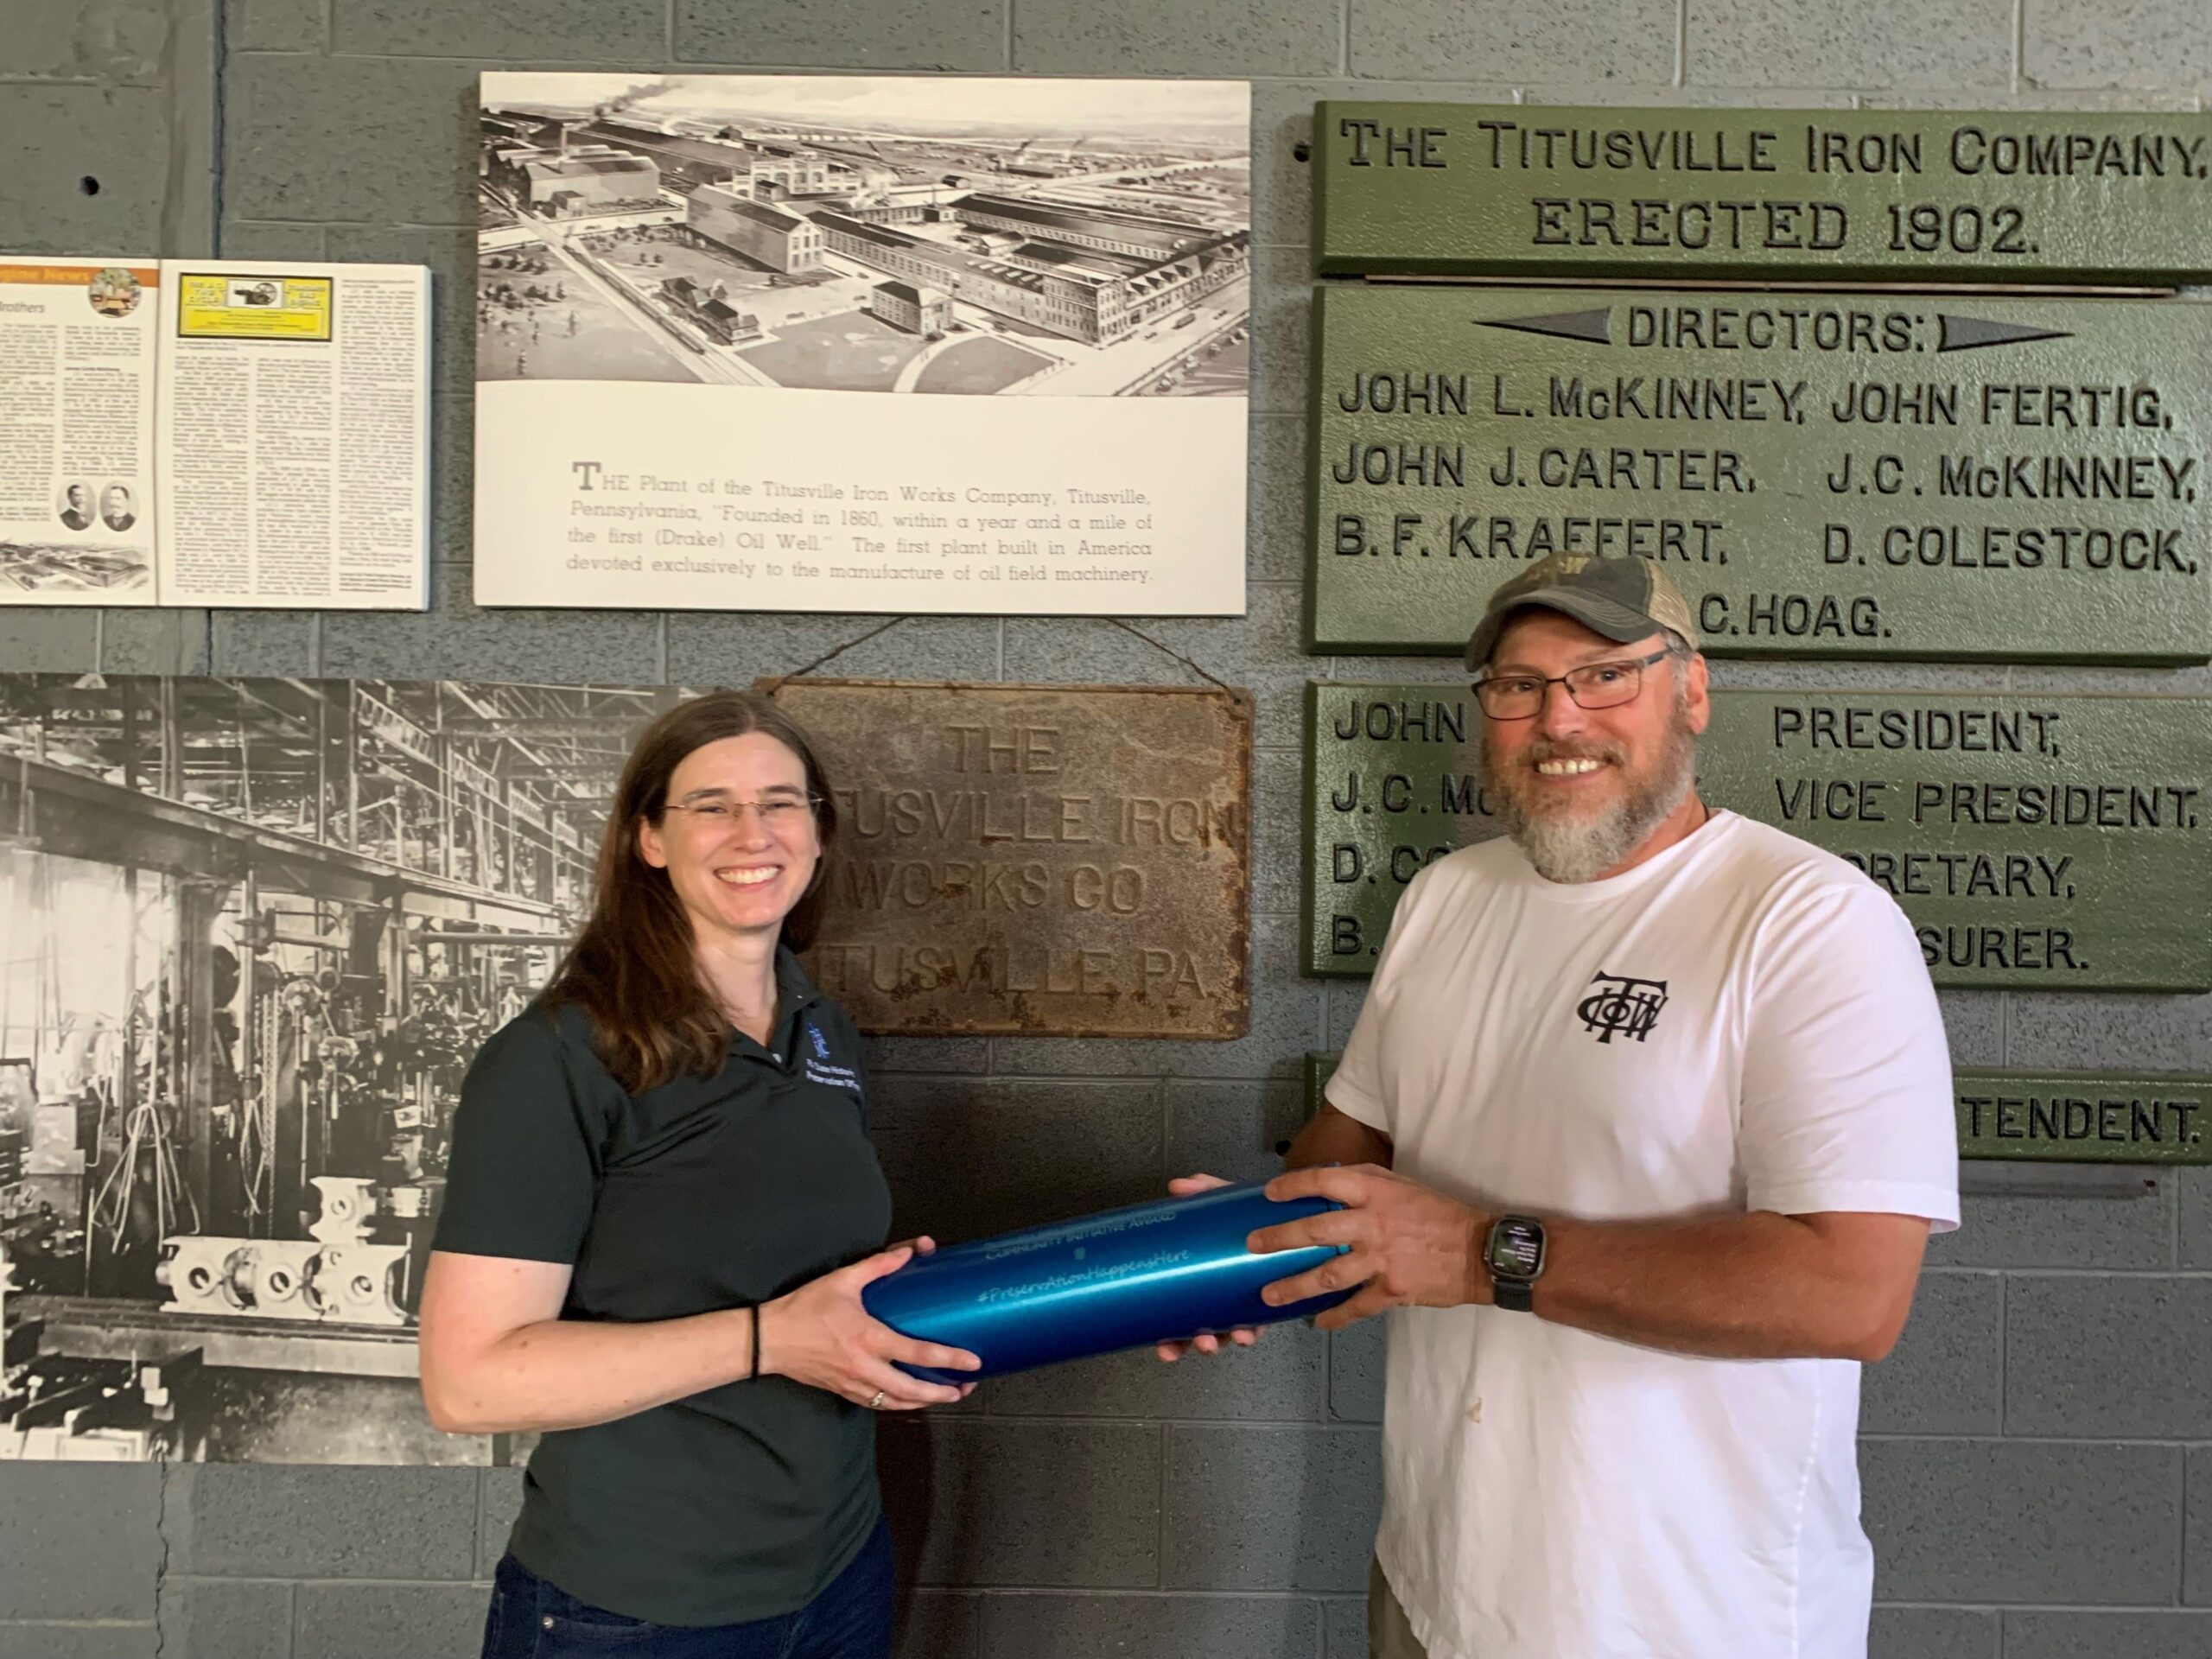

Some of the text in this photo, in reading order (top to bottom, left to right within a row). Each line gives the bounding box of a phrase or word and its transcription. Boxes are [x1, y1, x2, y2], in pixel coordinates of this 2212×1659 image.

[1340, 118, 2209, 179] THE TITUSVILLE IRON COMPANY,
[1532, 197, 2039, 254] ERECTED 1902.
[1629, 306, 1925, 353] DIRECTORS:
[1338, 372, 2174, 430] JOHN L. McKINNEY, JOHN FERTIG,
[639, 474, 688, 493] Plant
[697, 477, 715, 493] of
[724, 480, 753, 495] the
[762, 480, 844, 500] Titusville
[853, 485, 889, 501] Iron
[899, 486, 957, 502] Works
[966, 487, 1057, 506] Company,
[1066, 488, 1151, 505] Titusville,
[1333, 442, 1465, 487] JOHN
[1940, 455, 2196, 504] McKINNEY,
[570, 499, 702, 520] Pennsylvania,
[812, 510, 830, 524] in
[840, 510, 883, 528] 1860,
[893, 513, 948, 529] within
[957, 518, 969, 529] a
[976, 518, 1018, 531] year
[1026, 514, 1061, 530] and
[1068, 518, 1080, 530] a
[1090, 515, 1127, 530] mile
[1135, 514, 1153, 530] of
[568, 527, 596, 543] the
[608, 528, 643, 544] first
[655, 529, 725, 548] (Drake)
[736, 531, 765, 549] Oil
[851, 537, 886, 553] The
[896, 537, 931, 554] first
[941, 539, 988, 557] plant
[997, 540, 1039, 555] built
[1048, 540, 1065, 556] in
[1077, 540, 1153, 556] America
[1450, 516, 1728, 565] KRAFFERT,
[1824, 524, 1866, 566] D.
[1884, 525, 2198, 575] COLESTOCK,
[566, 555, 1154, 584] devoted exclusively to the manufacture of oil field machinery.
[949, 724, 1060, 775] THE
[1334, 701, 2060, 757] JOHN PRESIDENT,
[1775, 779, 1886, 822] VICE
[1913, 781, 2198, 829] PRESIDENT,
[847, 863, 1049, 912] WORKS
[1333, 842, 1376, 884] D.
[1332, 914, 1379, 956] B.
[1143, 950, 1208, 1000] PA
[1961, 1096, 2200, 1144] TENDENT.
